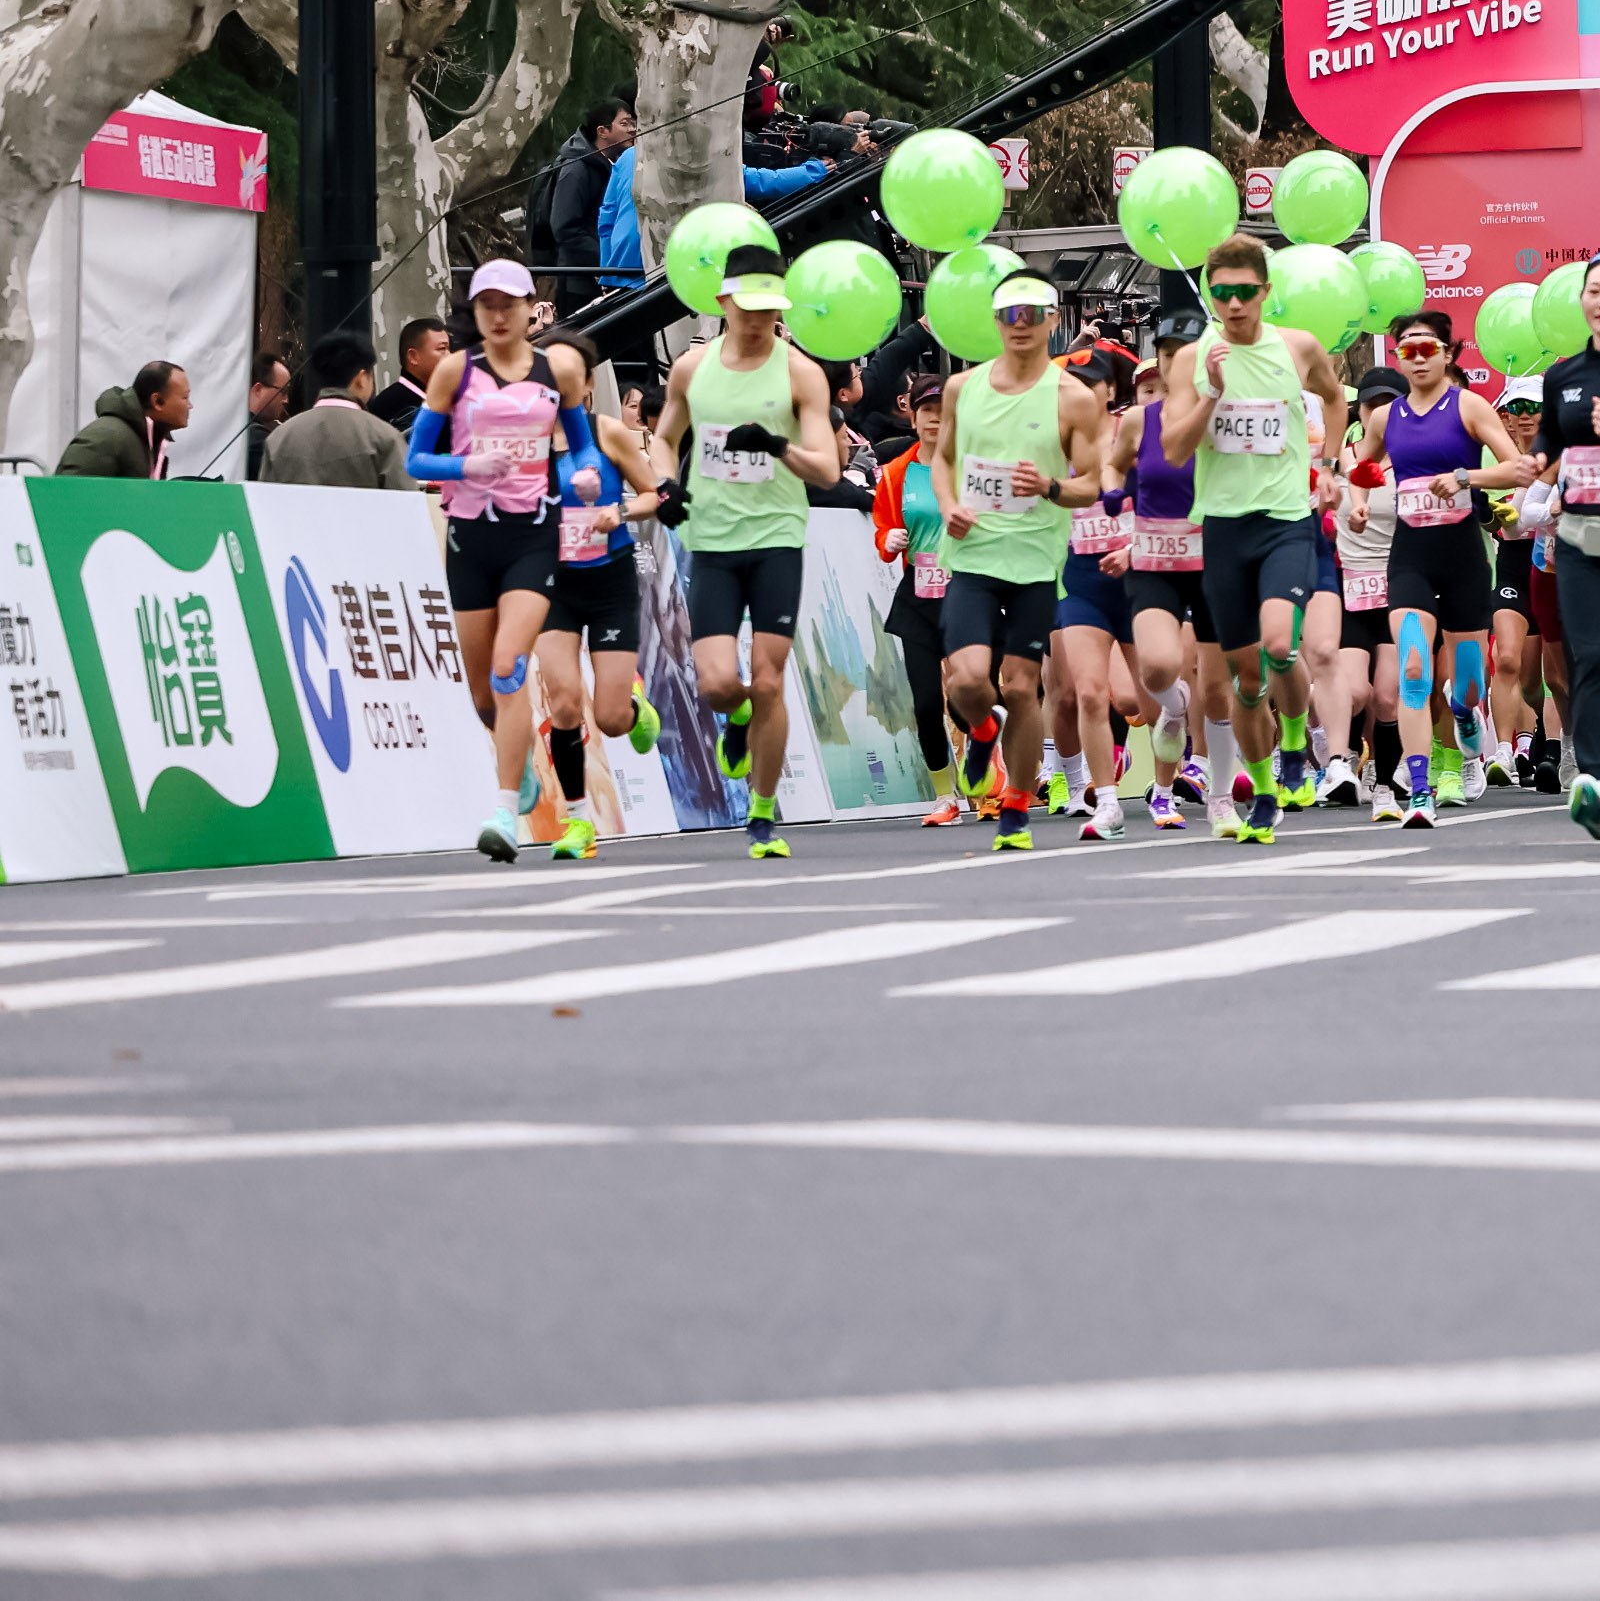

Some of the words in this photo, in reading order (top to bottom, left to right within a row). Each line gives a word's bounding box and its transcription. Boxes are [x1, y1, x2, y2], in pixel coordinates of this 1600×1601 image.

[1308, 42, 1374, 79] Run
[1382, 18, 1460, 59] Your
[1480, 215, 1509, 225] Official
[1511, 214, 1545, 224] Partners
[1215, 416, 1254, 437] PACE
[1262, 416, 1281, 437] 02
[703, 442, 740, 466] PACE
[967, 474, 1003, 497] PACE
[1081, 517, 1120, 539] 1150
[1146, 536, 1188, 556] 1285
[332, 581, 463, 683] 建信人寿
[363, 702, 399, 749] CCB
